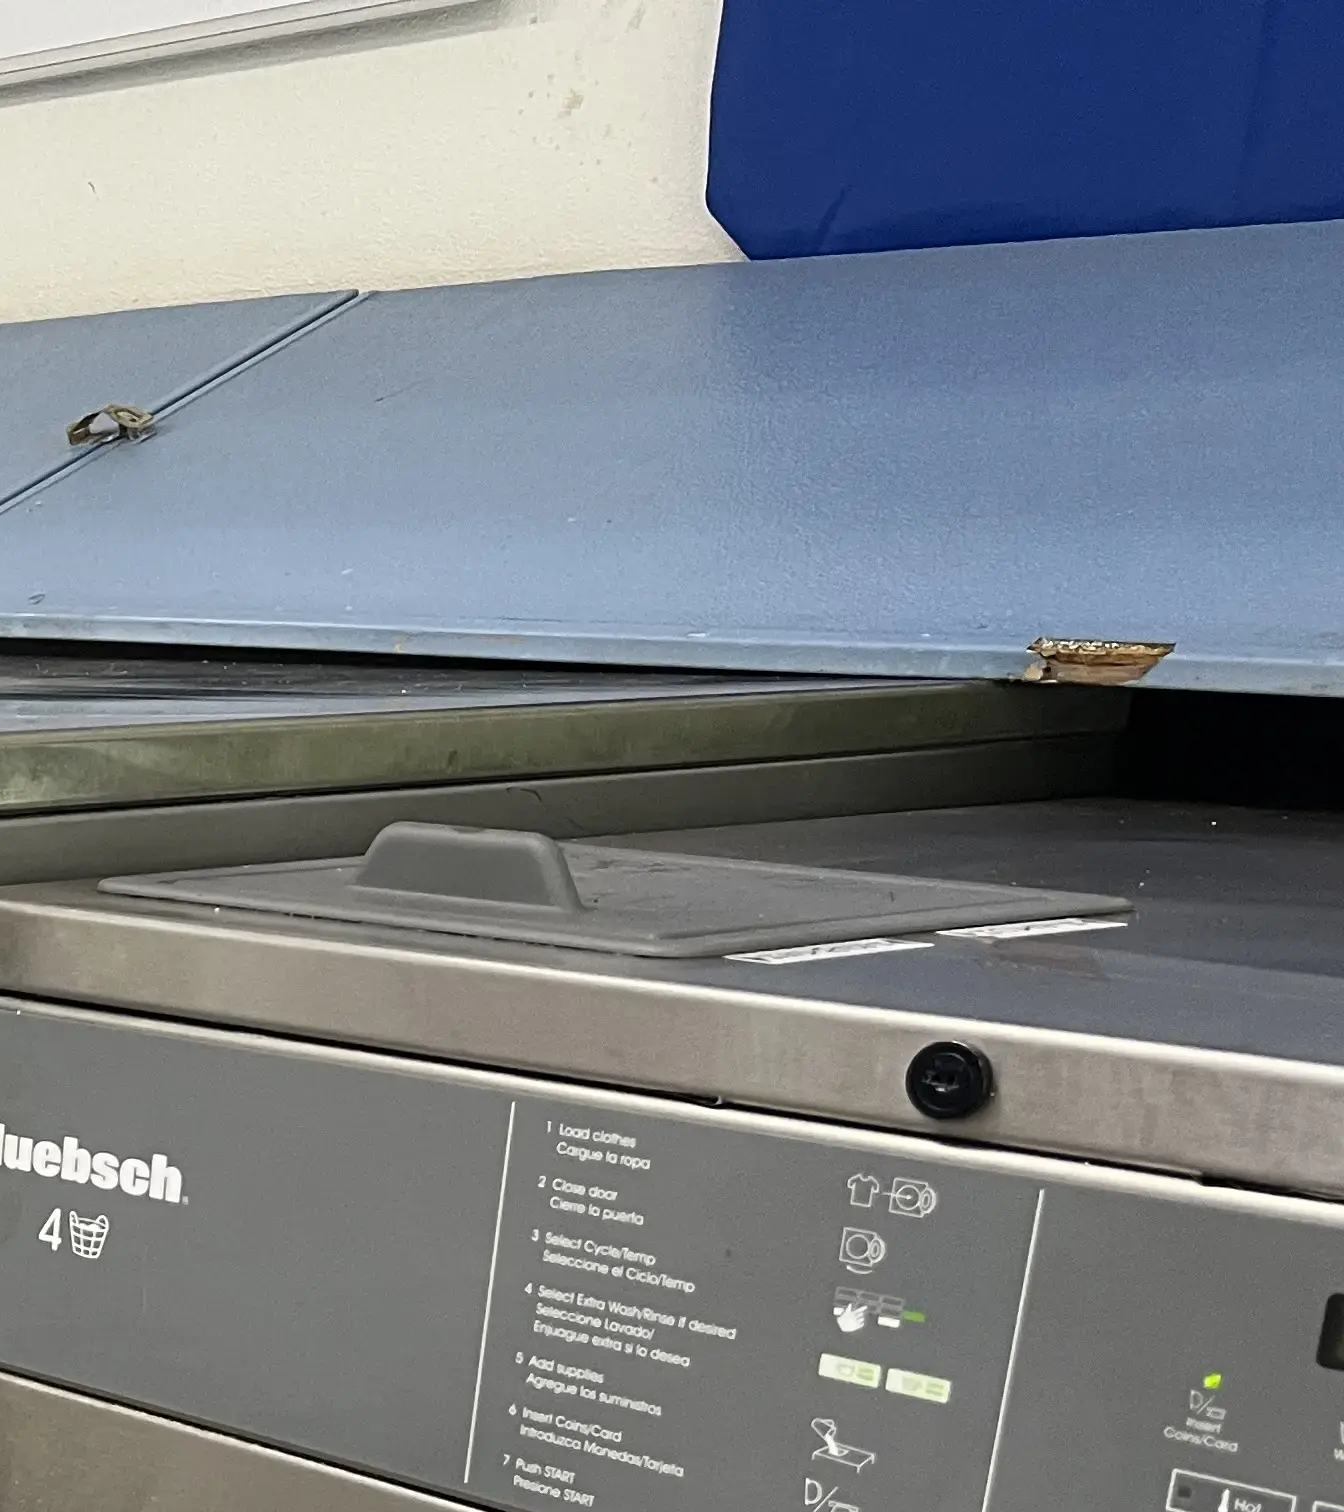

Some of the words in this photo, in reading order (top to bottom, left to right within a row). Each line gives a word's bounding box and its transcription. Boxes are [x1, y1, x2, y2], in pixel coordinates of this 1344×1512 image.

[559, 1123, 591, 1140] Load
[556, 1141, 603, 1161] Cargue
[605, 1151, 618, 1164] la
[619, 1155, 651, 1170] ropa
[537, 1175, 547, 1188] 2
[552, 1178, 586, 1196] Close
[588, 1186, 618, 1201] door
[588, 1203, 601, 1217] la
[602, 1208, 645, 1226] puerta
[38, 1208, 62, 1251] 4
[531, 1229, 540, 1242] 3
[545, 1231, 582, 1250] Select
[625, 1267, 696, 1294] Ciclo/Temp
[524, 1282, 533, 1295] 4
[537, 1285, 575, 1304] Select
[515, 1351, 524, 1364] 5
[528, 1355, 555, 1372] Add
[650, 1348, 691, 1368] desea
[508, 1403, 517, 1416] 6
[515, 1457, 542, 1475] Push
[544, 1465, 576, 1484] START
[563, 1488, 595, 1507] START
